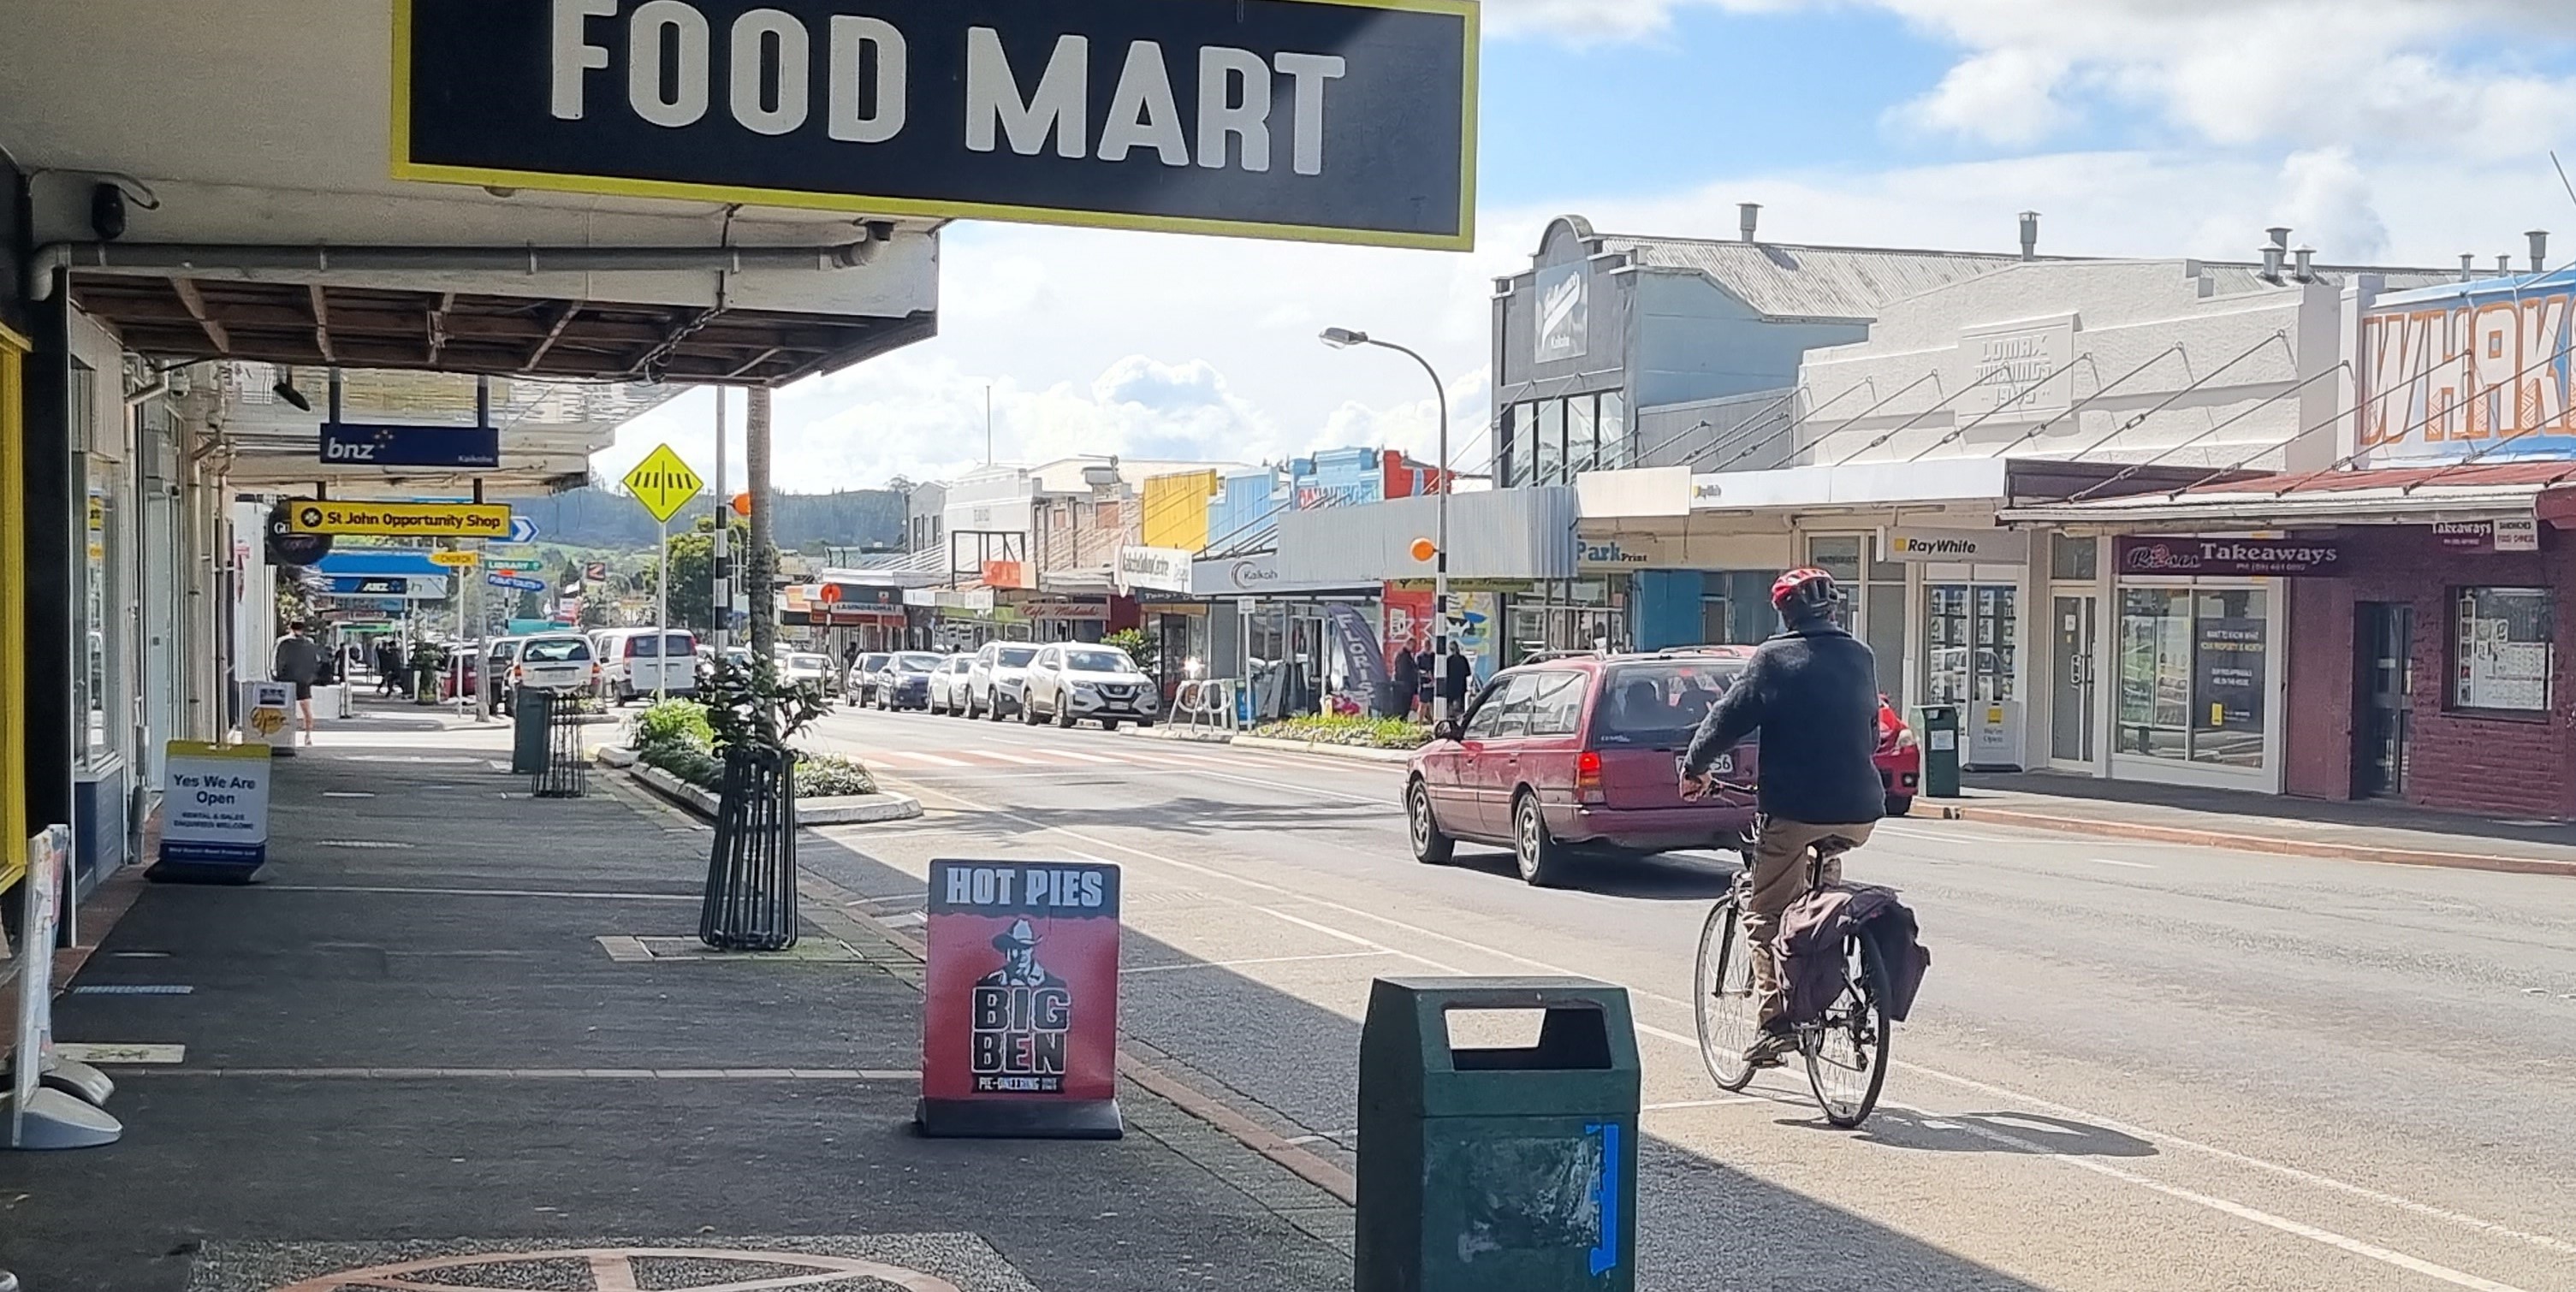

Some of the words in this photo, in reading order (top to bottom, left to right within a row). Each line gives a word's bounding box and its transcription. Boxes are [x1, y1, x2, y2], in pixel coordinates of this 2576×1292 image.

[551, 0, 907, 143] FOOD
[965, 26, 1346, 176] MART
[1981, 335, 2048, 363] LOMAX
[2360, 293, 2576, 446] WHAK
[327, 437, 375, 460] bnz
[328, 512, 342, 525] St
[345, 512, 379, 525] John
[383, 513, 463, 530] Opportunity
[466, 515, 502, 529] Shop
[1577, 542, 1622, 561] Park
[1621, 553, 1647, 562] Print
[2199, 542, 2337, 565] Takeaways
[362, 583, 389, 592] ANZ
[173, 774, 199, 788] Yes
[203, 776, 227, 789] We
[229, 777, 256, 790] Are
[196, 791, 235, 806] Open
[946, 867, 1016, 905] HOT
[1025, 868, 1103, 908] PIES
[972, 987, 1071, 1032] BIG
[970, 1031, 1068, 1075] BEN
